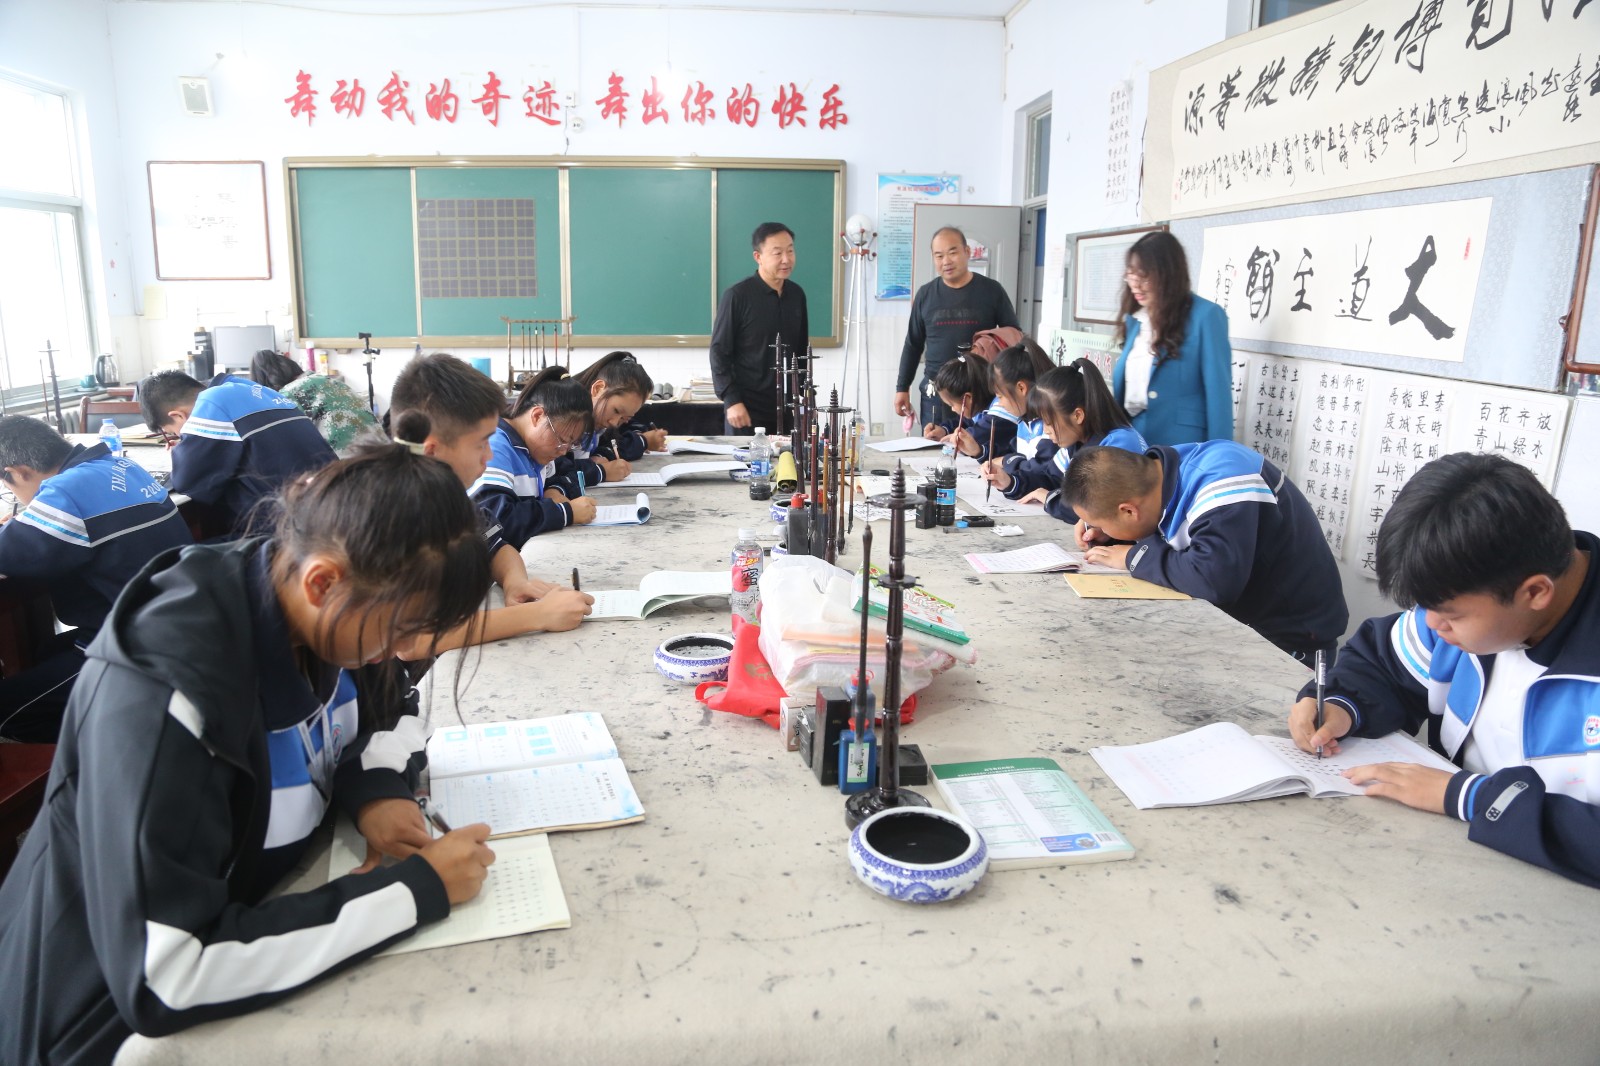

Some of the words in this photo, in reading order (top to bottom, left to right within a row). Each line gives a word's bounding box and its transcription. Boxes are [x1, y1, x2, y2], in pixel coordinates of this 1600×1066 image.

[284, 70, 562, 127] 舞动我的奇迹
[595, 72, 849, 130] 舞出你的快乐
